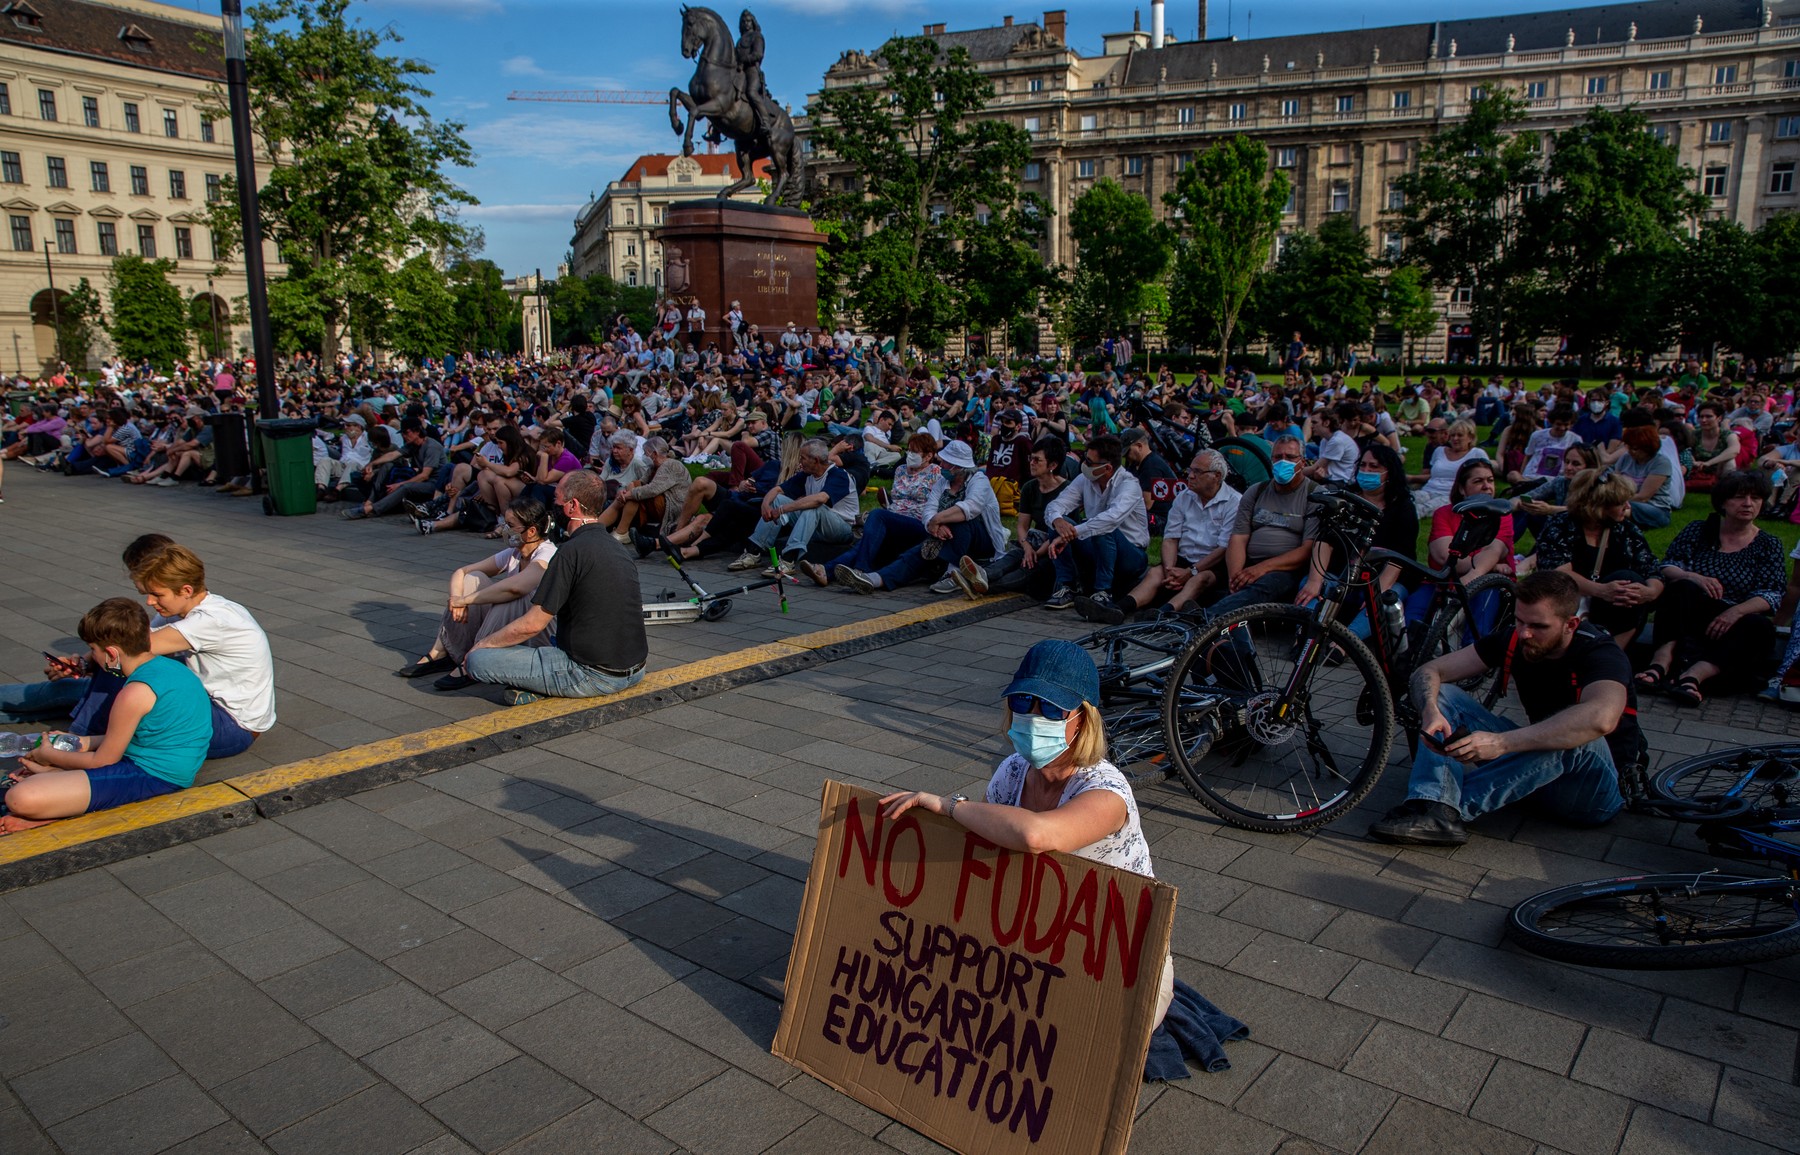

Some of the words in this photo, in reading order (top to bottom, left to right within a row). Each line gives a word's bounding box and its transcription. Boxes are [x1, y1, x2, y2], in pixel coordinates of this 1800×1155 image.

[839, 797, 925, 907] NO
[954, 830, 1152, 988] FUDAN
[830, 946, 1058, 1082] HUNGARIAN
[873, 910, 1066, 1019] SUPPORT
[823, 994, 1053, 1143] EDUCATION
